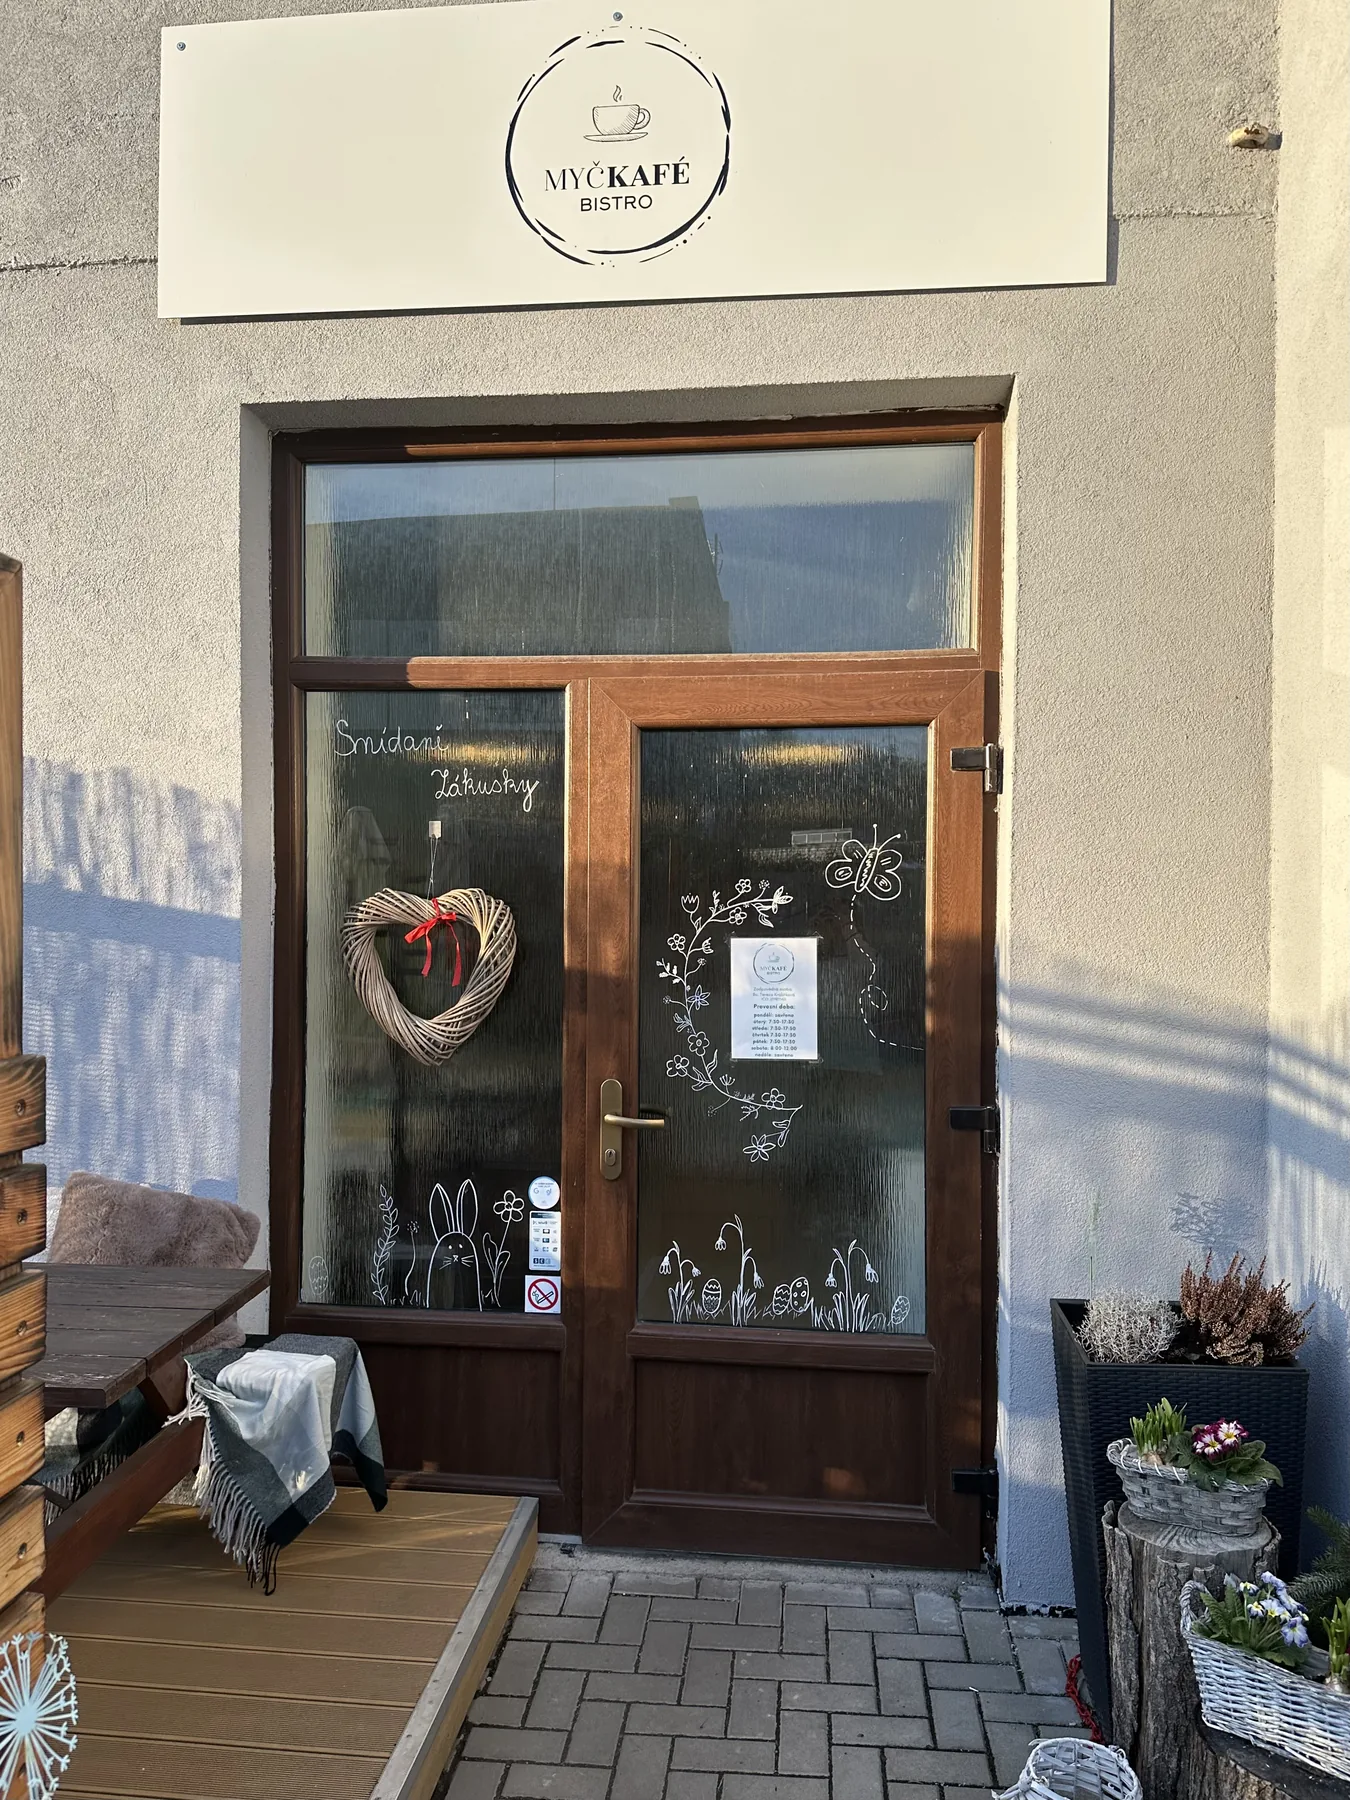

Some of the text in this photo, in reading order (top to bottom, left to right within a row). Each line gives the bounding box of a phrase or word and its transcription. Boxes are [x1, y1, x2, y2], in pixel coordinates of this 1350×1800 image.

[545, 156, 690, 192] MYČKAFÉ
[580, 194, 653, 212] BISTRO
[430, 767, 540, 813] Zákusky
